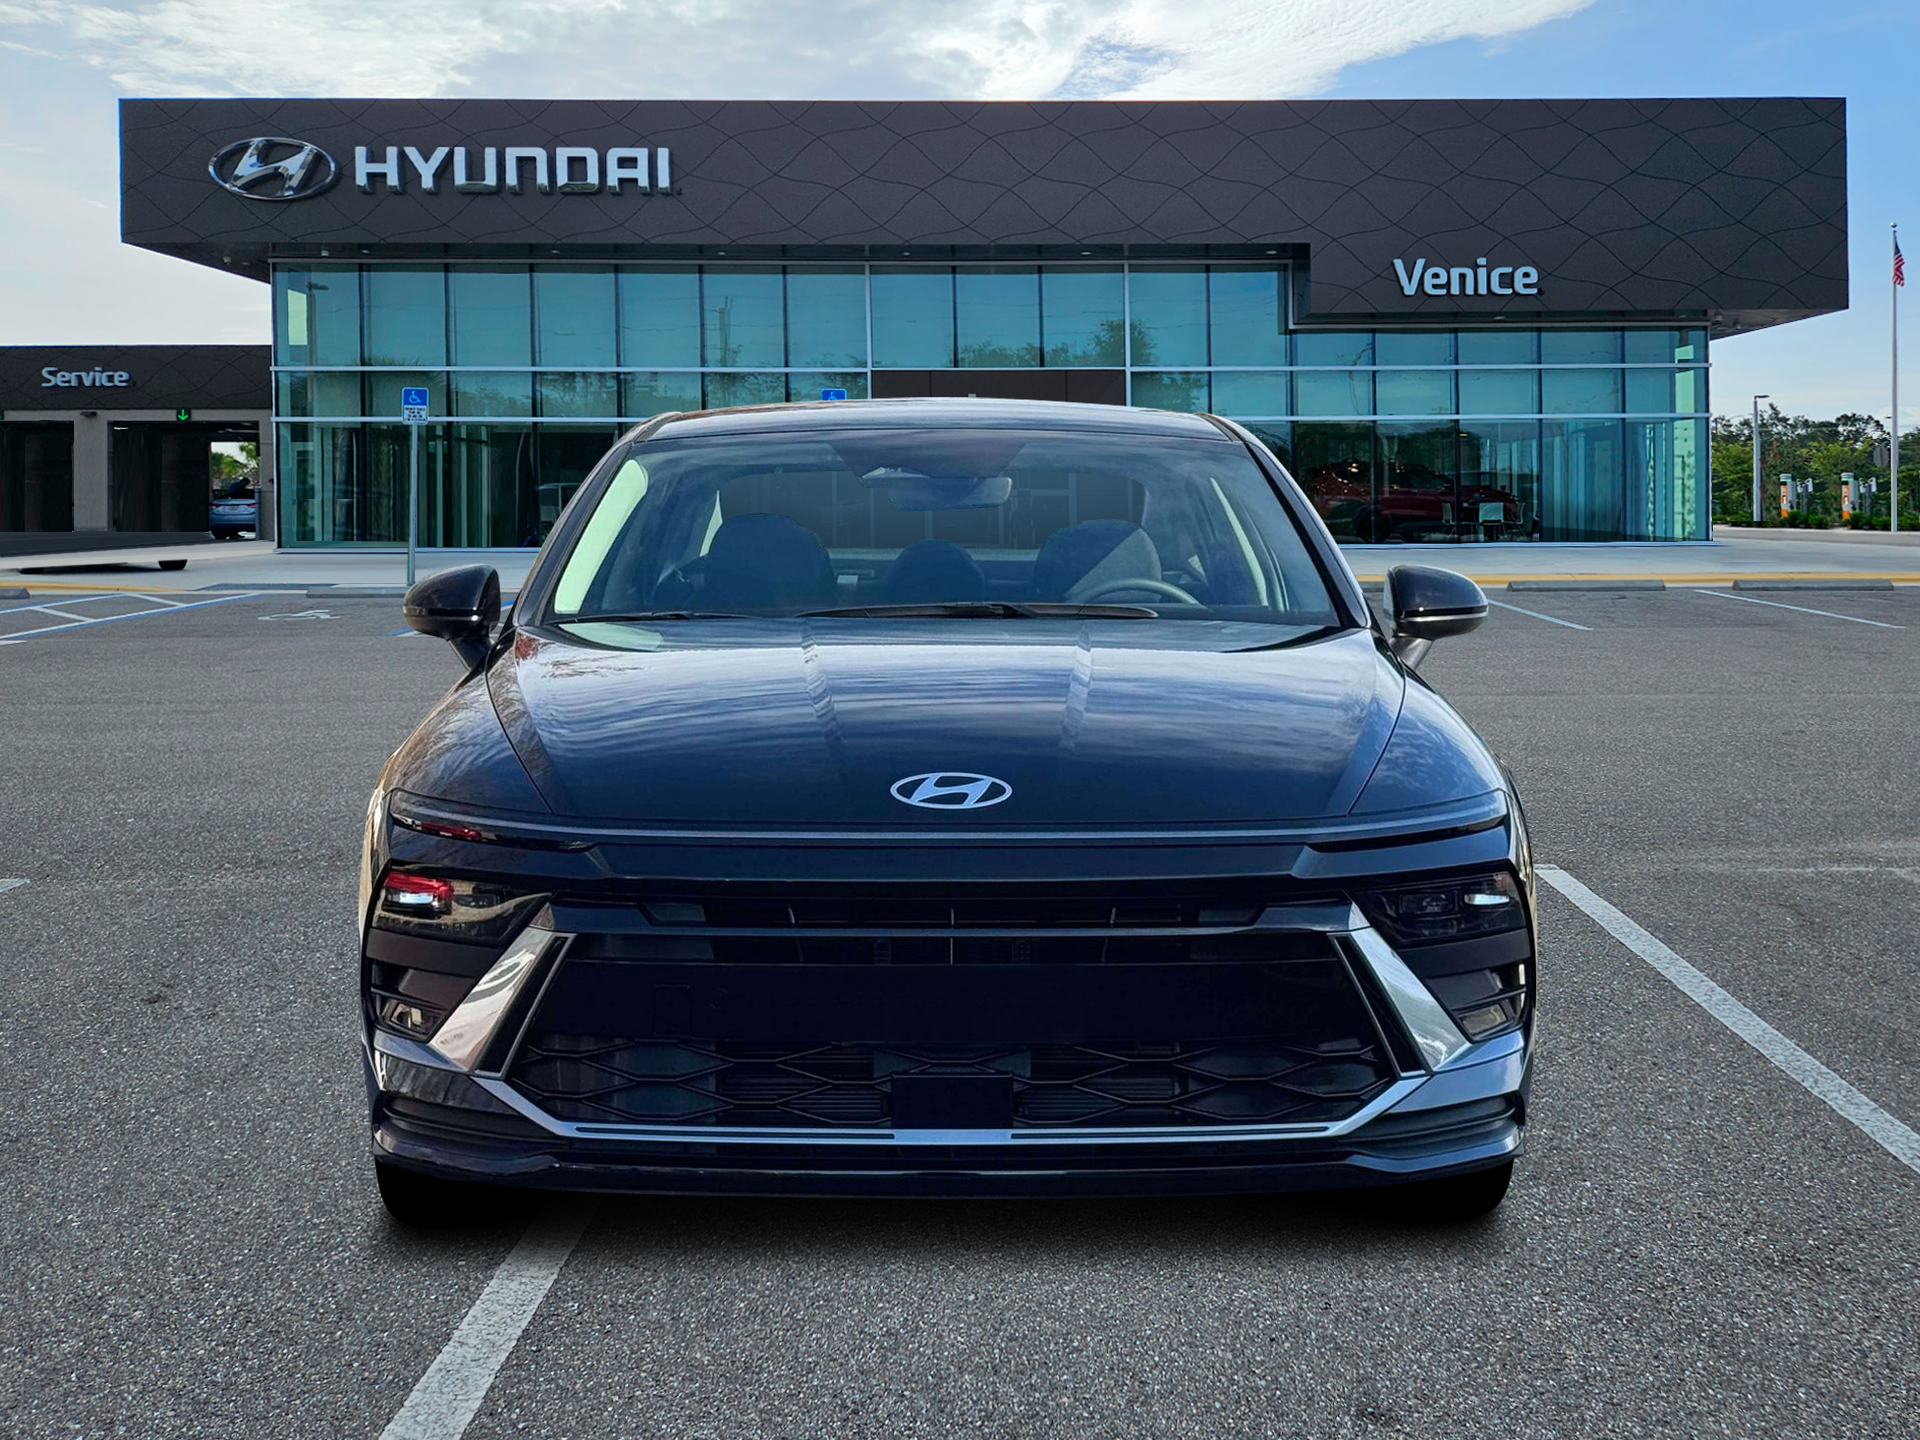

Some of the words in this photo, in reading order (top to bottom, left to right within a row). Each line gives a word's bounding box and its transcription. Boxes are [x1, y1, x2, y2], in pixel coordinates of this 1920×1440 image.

[354, 146, 672, 194] HYUNDAI
[1393, 257, 1539, 296] Venice
[41, 366, 129, 387] Service
